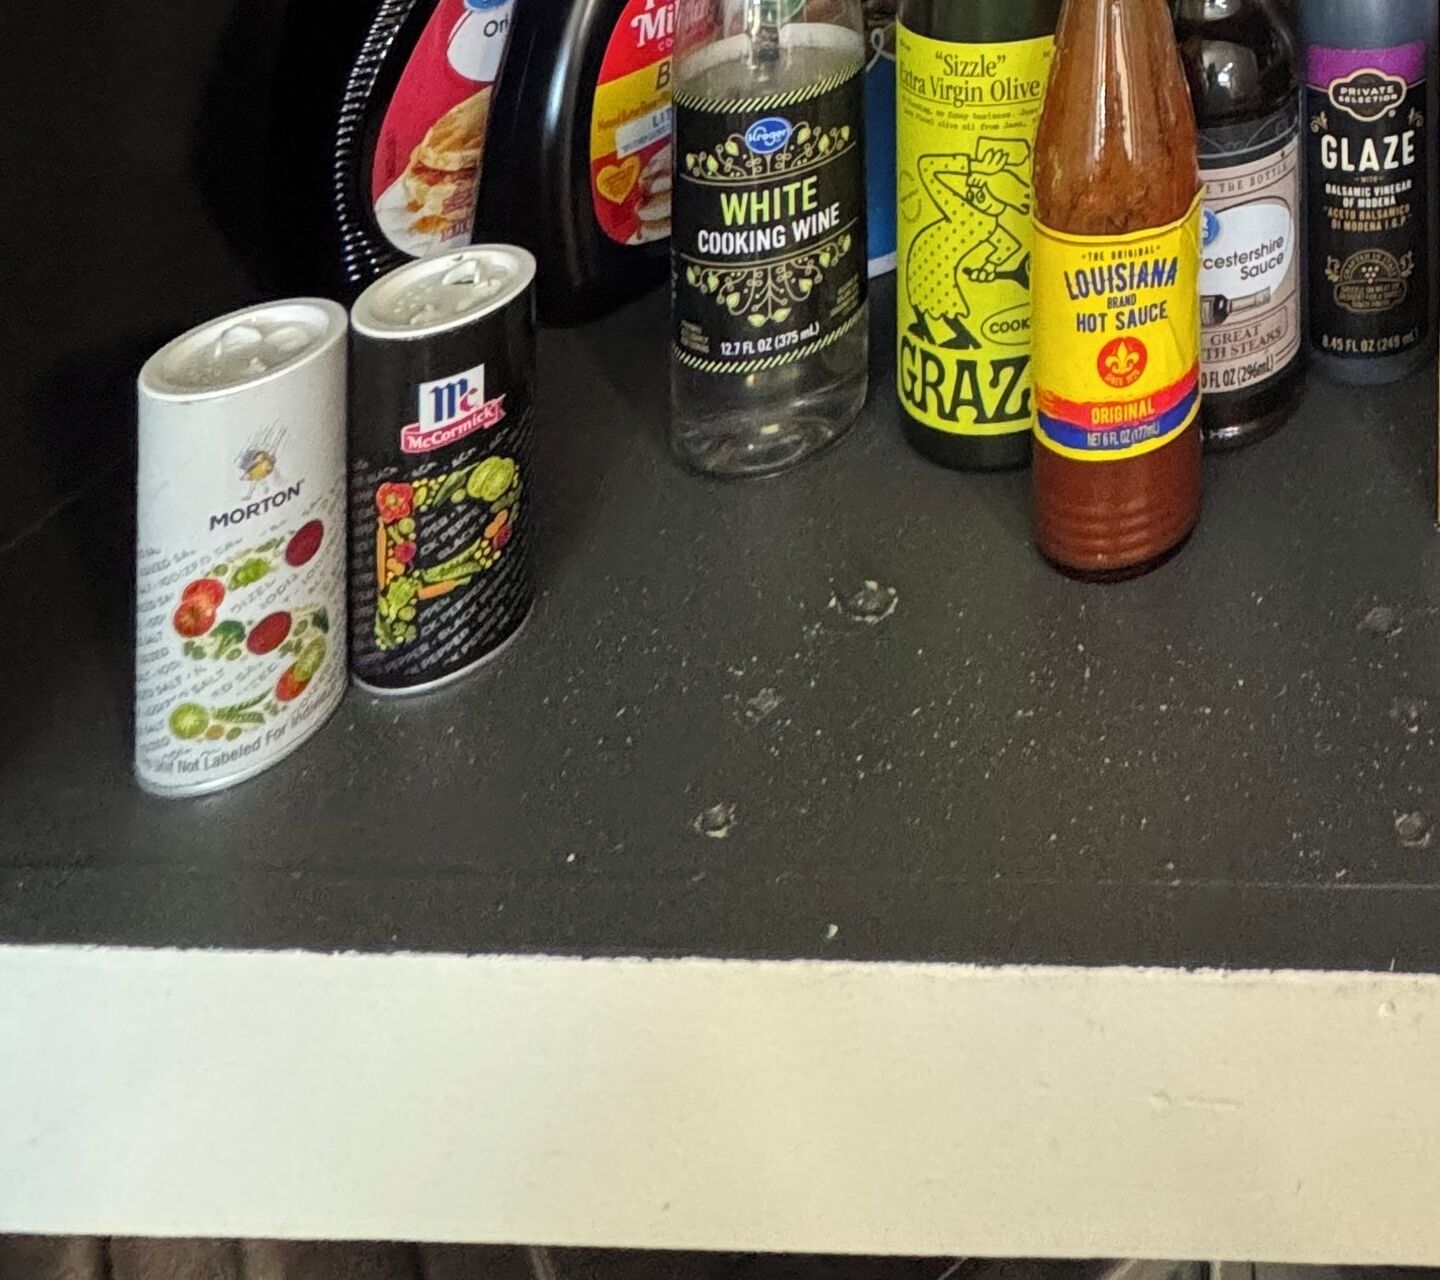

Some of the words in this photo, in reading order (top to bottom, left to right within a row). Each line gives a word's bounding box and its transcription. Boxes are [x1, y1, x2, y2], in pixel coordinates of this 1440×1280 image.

[929, 76, 983, 108] Virgin
[991, 78, 1040, 102] Olive
[1338, 94, 1398, 104] SELECTION
[1340, 85, 1394, 95] PRIVATE
[747, 126, 787, 147] Kroger
[1321, 130, 1415, 172] GLAZE
[720, 175, 818, 227] WHITE
[1325, 183, 1371, 197] BALSAMIC
[1374, 179, 1412, 196] VINEGAR
[1343, 198, 1354, 208] OF
[1358, 196, 1396, 208] MODENA
[698, 225, 786, 255] COOKING
[791, 201, 841, 243] WINE
[1088, 251, 1105, 261] THE
[1111, 246, 1154, 261] ORIGINAL
[1203, 236, 1284, 270] cestershire
[1240, 252, 1284, 281] Sauce
[1064, 257, 1178, 301] LOUISIANA
[1076, 312, 1108, 333] HOT
[1115, 300, 1168, 331] SAUCE
[1107, 294, 1137, 309] BRAND
[720, 341, 741, 356] 12.7
[742, 340, 755, 355] FL
[757, 337, 772, 351] OZ
[774, 331, 799, 351] (375
[800, 321, 820, 342] mL)
[1210, 325, 1262, 345] GREAT
[1237, 325, 1282, 358] STEAKS
[901, 335, 1031, 424] GRAZ
[408, 406, 494, 450] McCormick
[1091, 399, 1155, 425] ORIGINAL
[209, 481, 302, 532] MORTON
[177, 755, 199, 774] Not
[204, 735, 261, 771] Labeled
[266, 722, 287, 747] For
